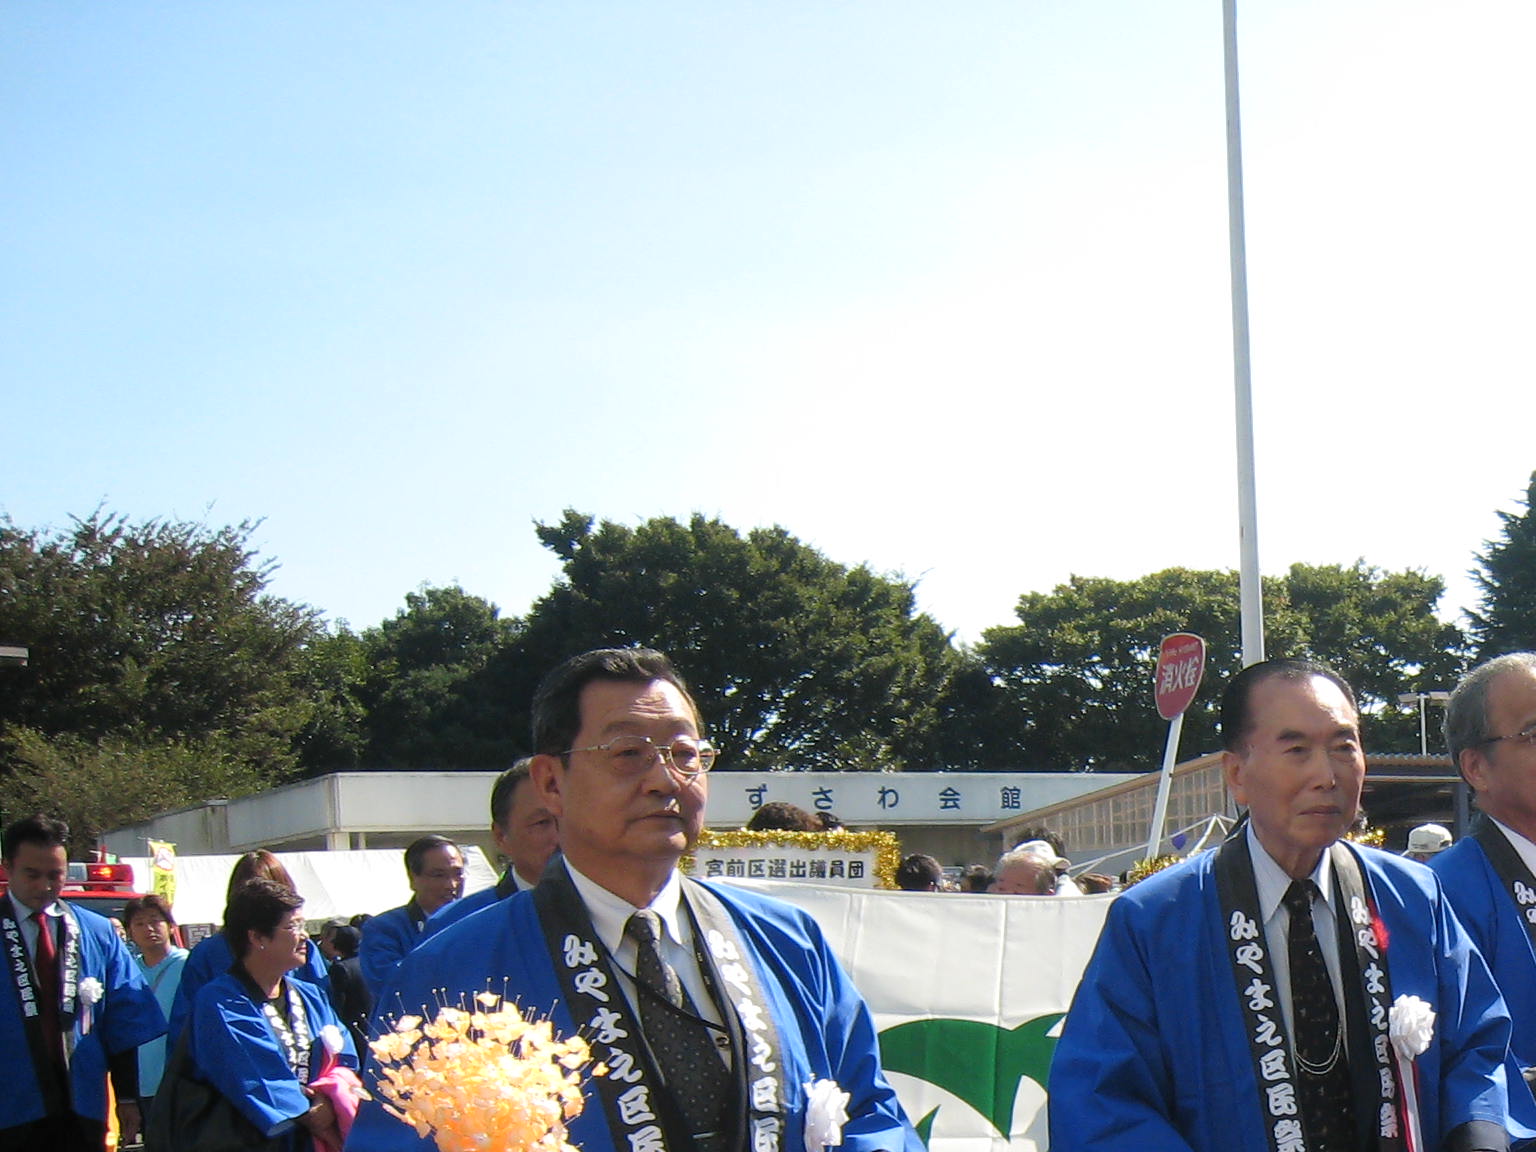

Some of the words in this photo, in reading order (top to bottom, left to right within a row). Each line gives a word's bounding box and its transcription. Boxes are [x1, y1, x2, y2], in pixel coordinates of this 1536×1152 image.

[1160, 656, 1200, 695] 消火栓
[705, 859, 864, 880] 宮前区選出議員団
[1351, 896, 1399, 1138] みやまえ区民祭
